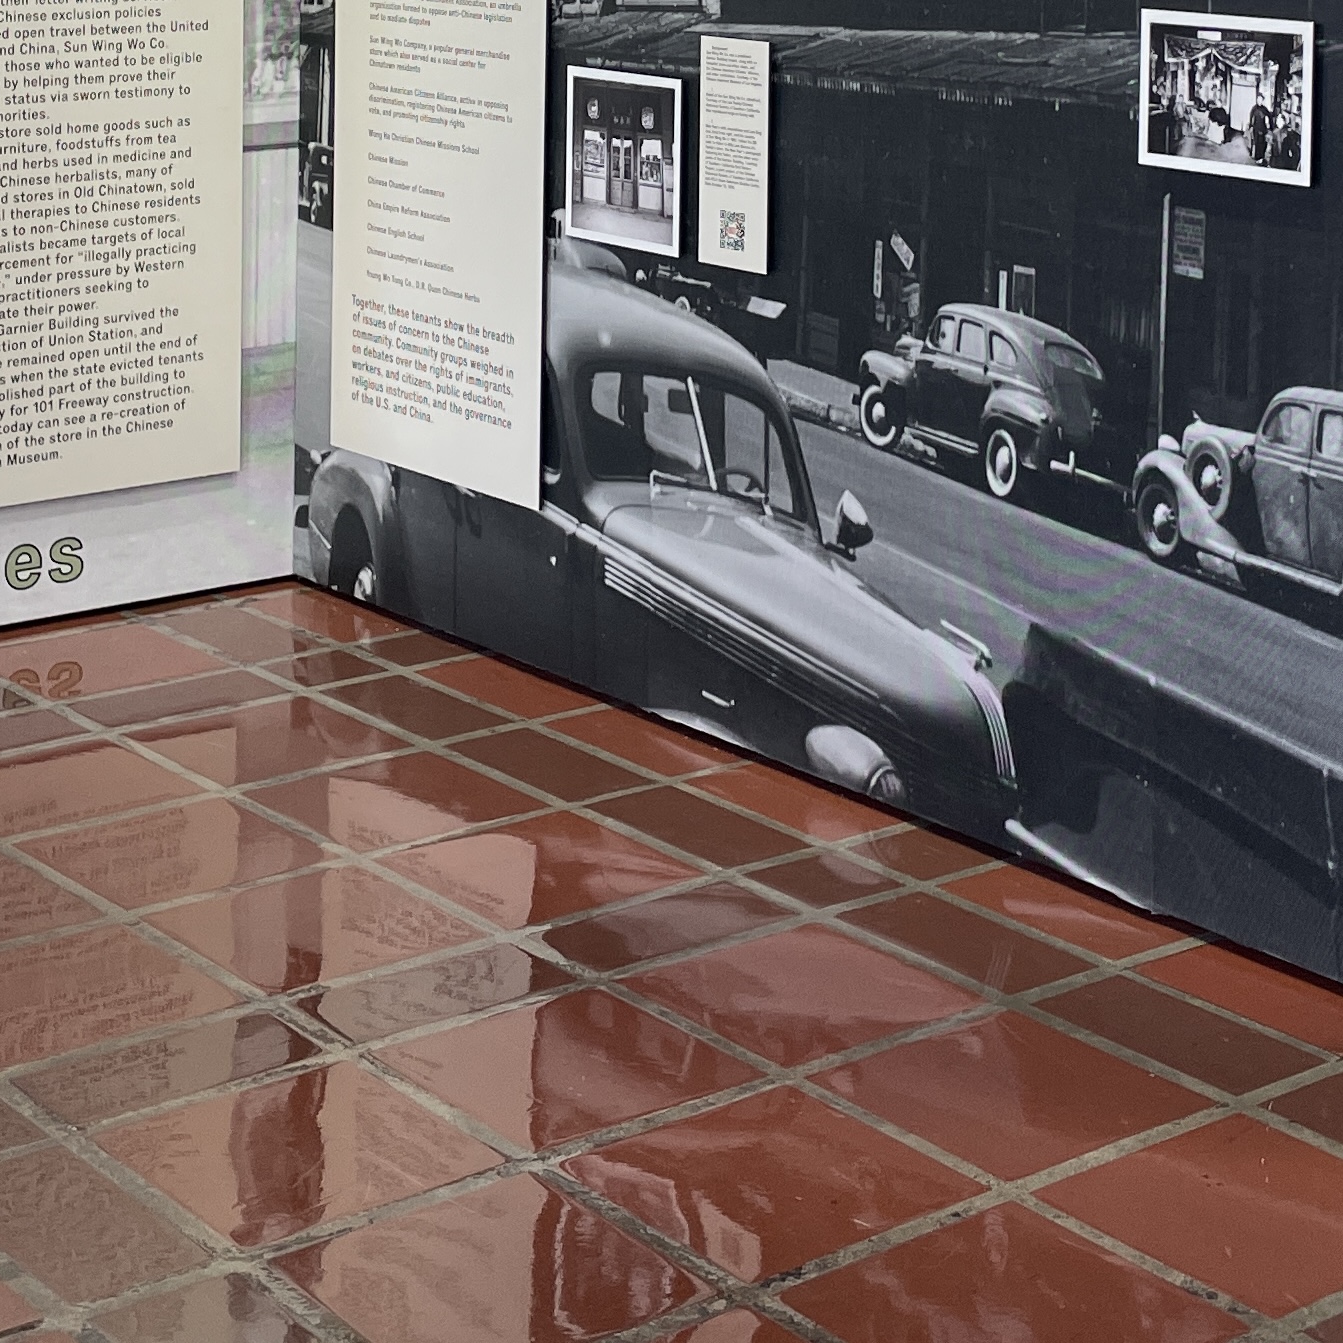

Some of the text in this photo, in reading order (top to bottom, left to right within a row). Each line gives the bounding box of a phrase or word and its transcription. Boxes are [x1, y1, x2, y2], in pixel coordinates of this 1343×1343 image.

[10, 404, 29, 416] for
[32, 399, 53, 413] 101
[58, 396, 109, 410] Freeway
[112, 385, 194, 403] construction.
[351, 389, 433, 423] of the U.S. and China.
[6, 451, 62, 465] Museum.
